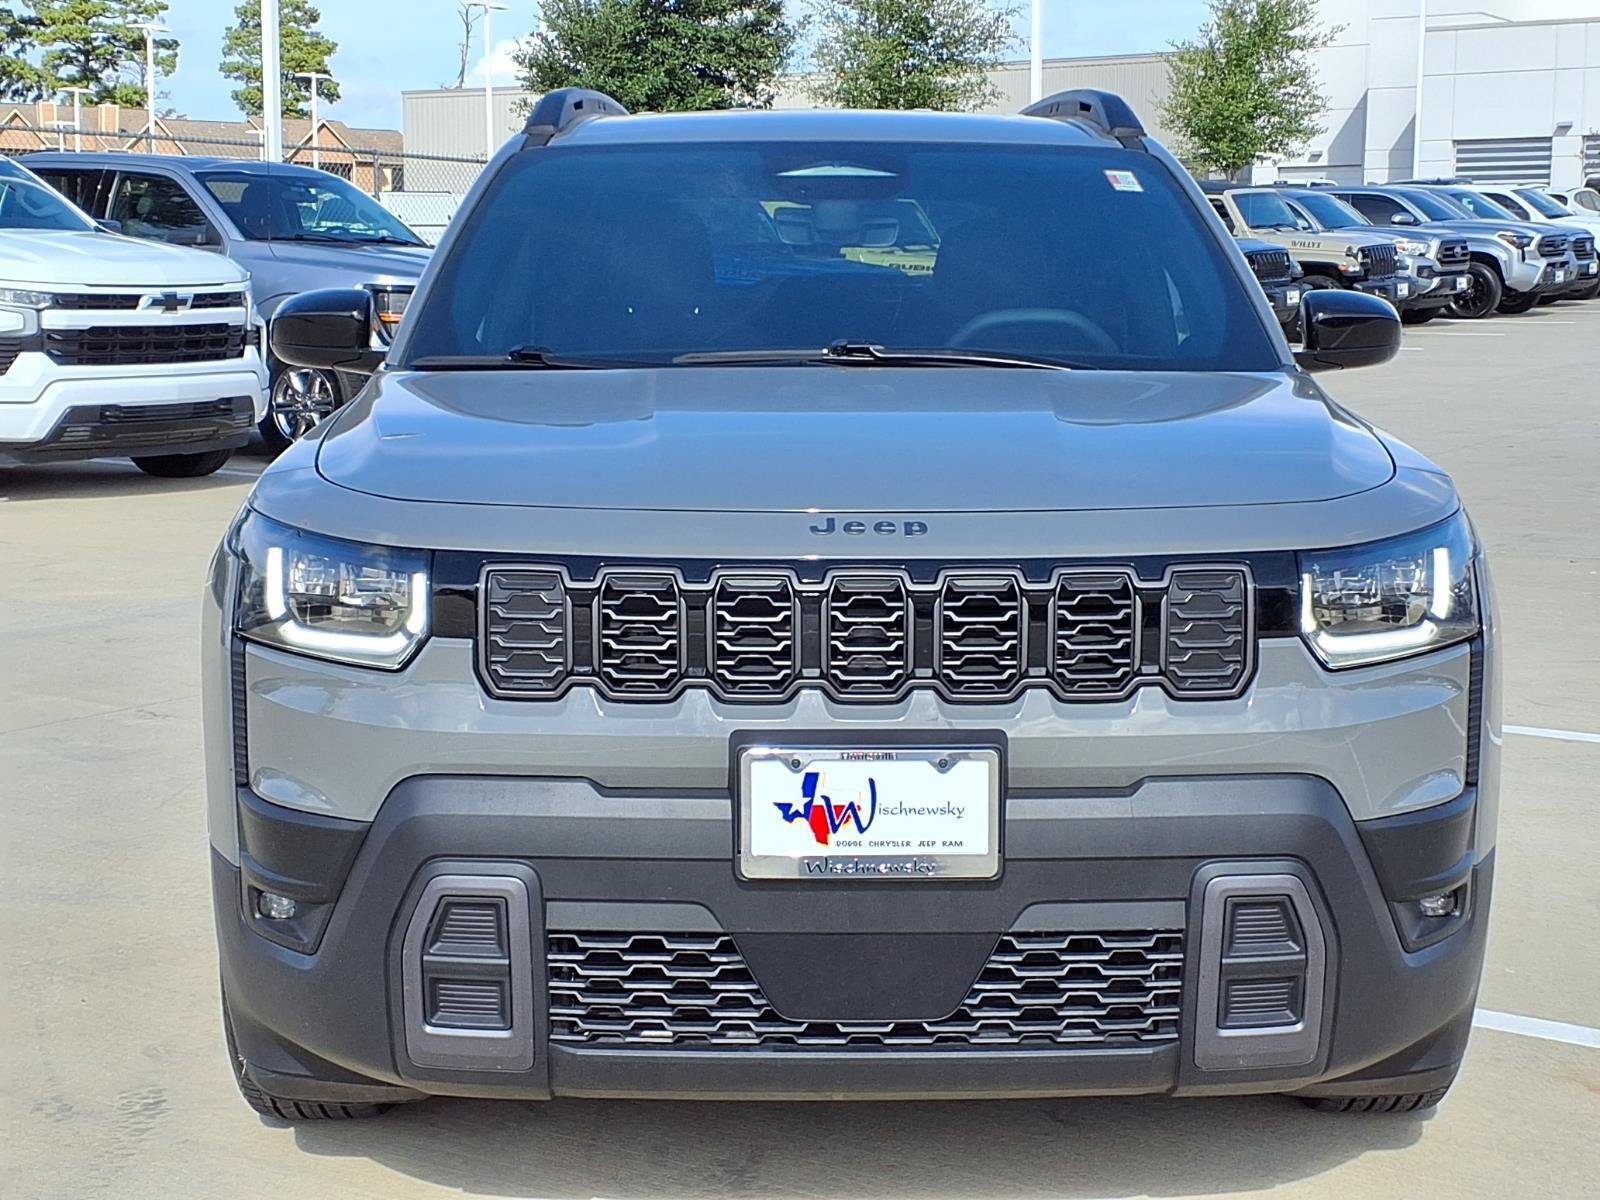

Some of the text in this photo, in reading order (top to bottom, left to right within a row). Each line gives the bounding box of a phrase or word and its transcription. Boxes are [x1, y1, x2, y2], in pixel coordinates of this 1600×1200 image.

[809, 517, 928, 537] Jeep
[820, 777, 965, 834] Wischnewsky
[804, 857, 936, 876] Wischnewsky
